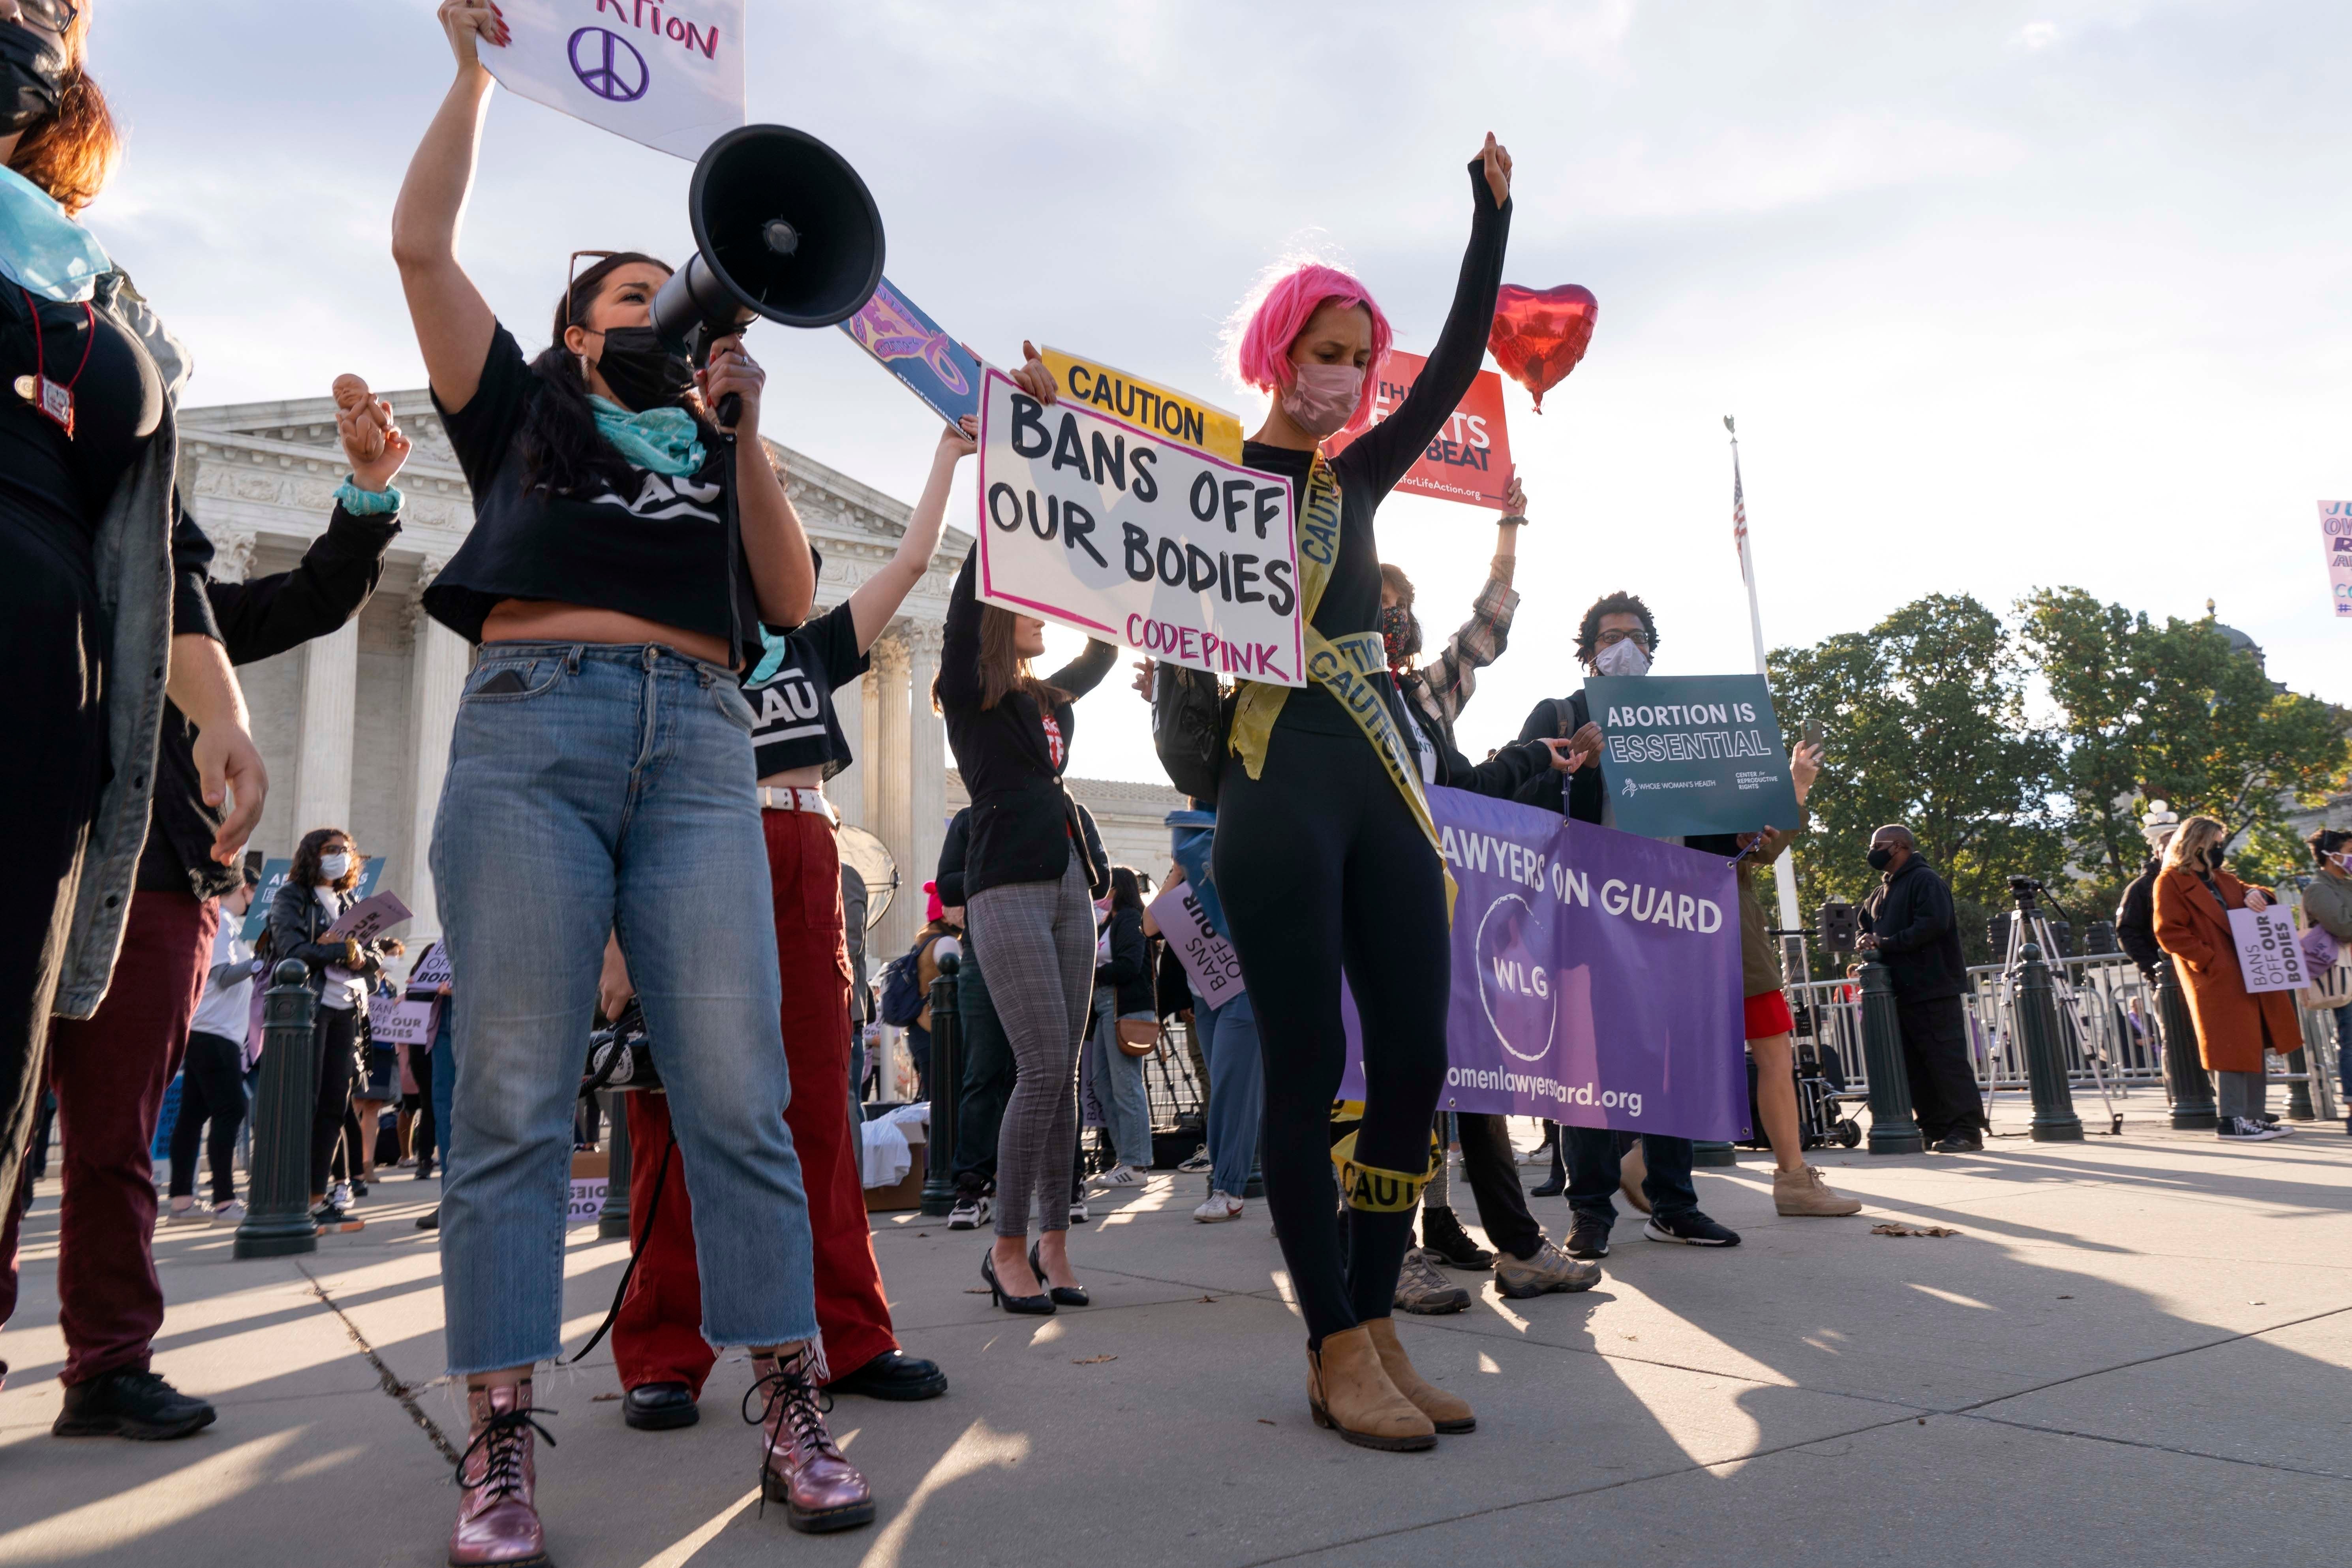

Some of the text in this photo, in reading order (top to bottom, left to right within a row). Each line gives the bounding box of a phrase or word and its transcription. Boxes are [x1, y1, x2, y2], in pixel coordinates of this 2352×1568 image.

[1068, 366, 1203, 445] CAUTION
[1011, 393, 1285, 539] BANS OFF
[1426, 439, 1491, 472] BEAT
[988, 482, 1295, 616] OUR BODIES
[1126, 612, 1290, 682] CODEPINK
[1308, 651, 1412, 786] CAUTION
[1607, 703, 1756, 727] ABORTION IS
[1608, 730, 1772, 763] ESSENTIAL
[1552, 862, 1589, 907] ON
[1600, 879, 1722, 934] GUARD
[1186, 938, 1227, 992] BANS
[1210, 942, 1241, 978] OFF
[1493, 956, 1549, 999] WLG
[2245, 945, 2268, 986] BANS
[2256, 915, 2284, 984] OFF OUR
[2275, 922, 2302, 982] BODIES
[391, 1017, 421, 1028] OUR
